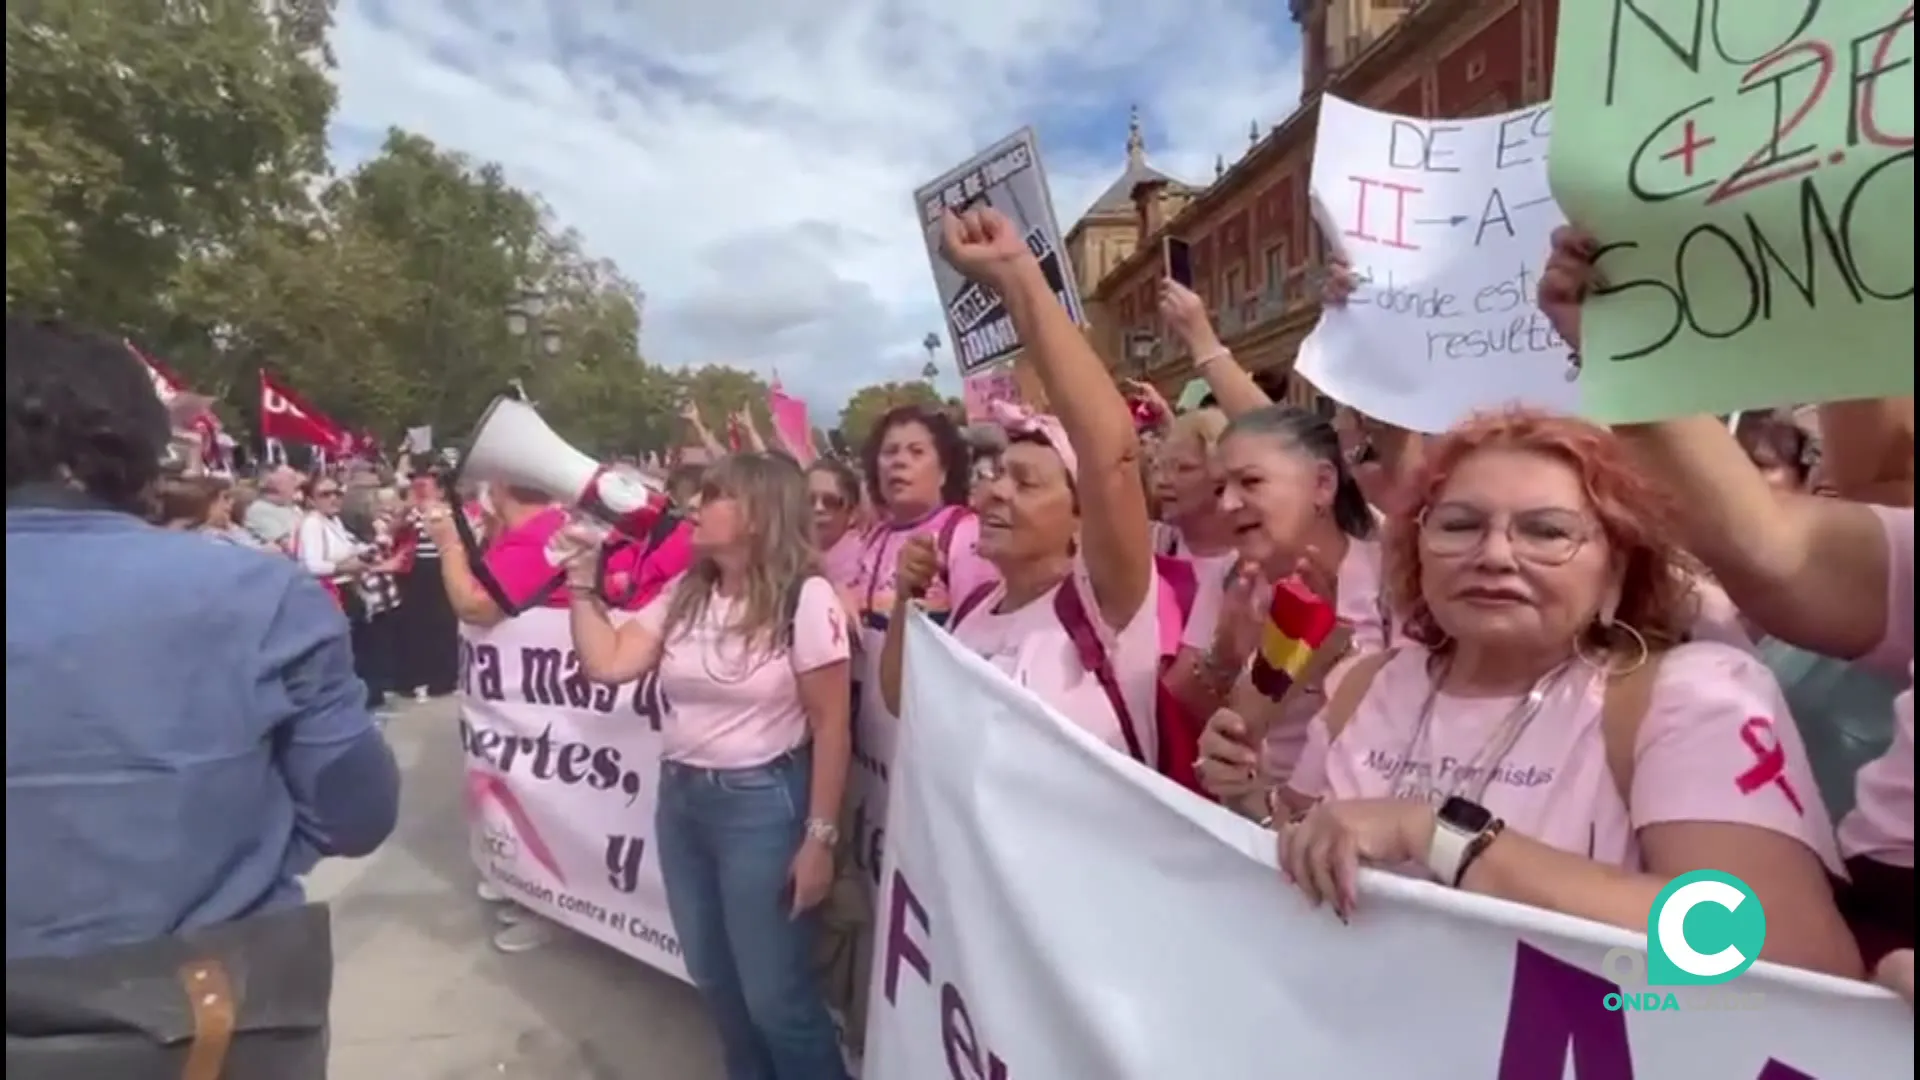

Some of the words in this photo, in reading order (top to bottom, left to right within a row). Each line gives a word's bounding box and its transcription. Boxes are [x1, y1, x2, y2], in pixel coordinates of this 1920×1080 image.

[1389, 120, 1463, 173] DE
[1474, 186, 1515, 246] A
[557, 893, 607, 923] contra
[610, 911, 626, 932] el
